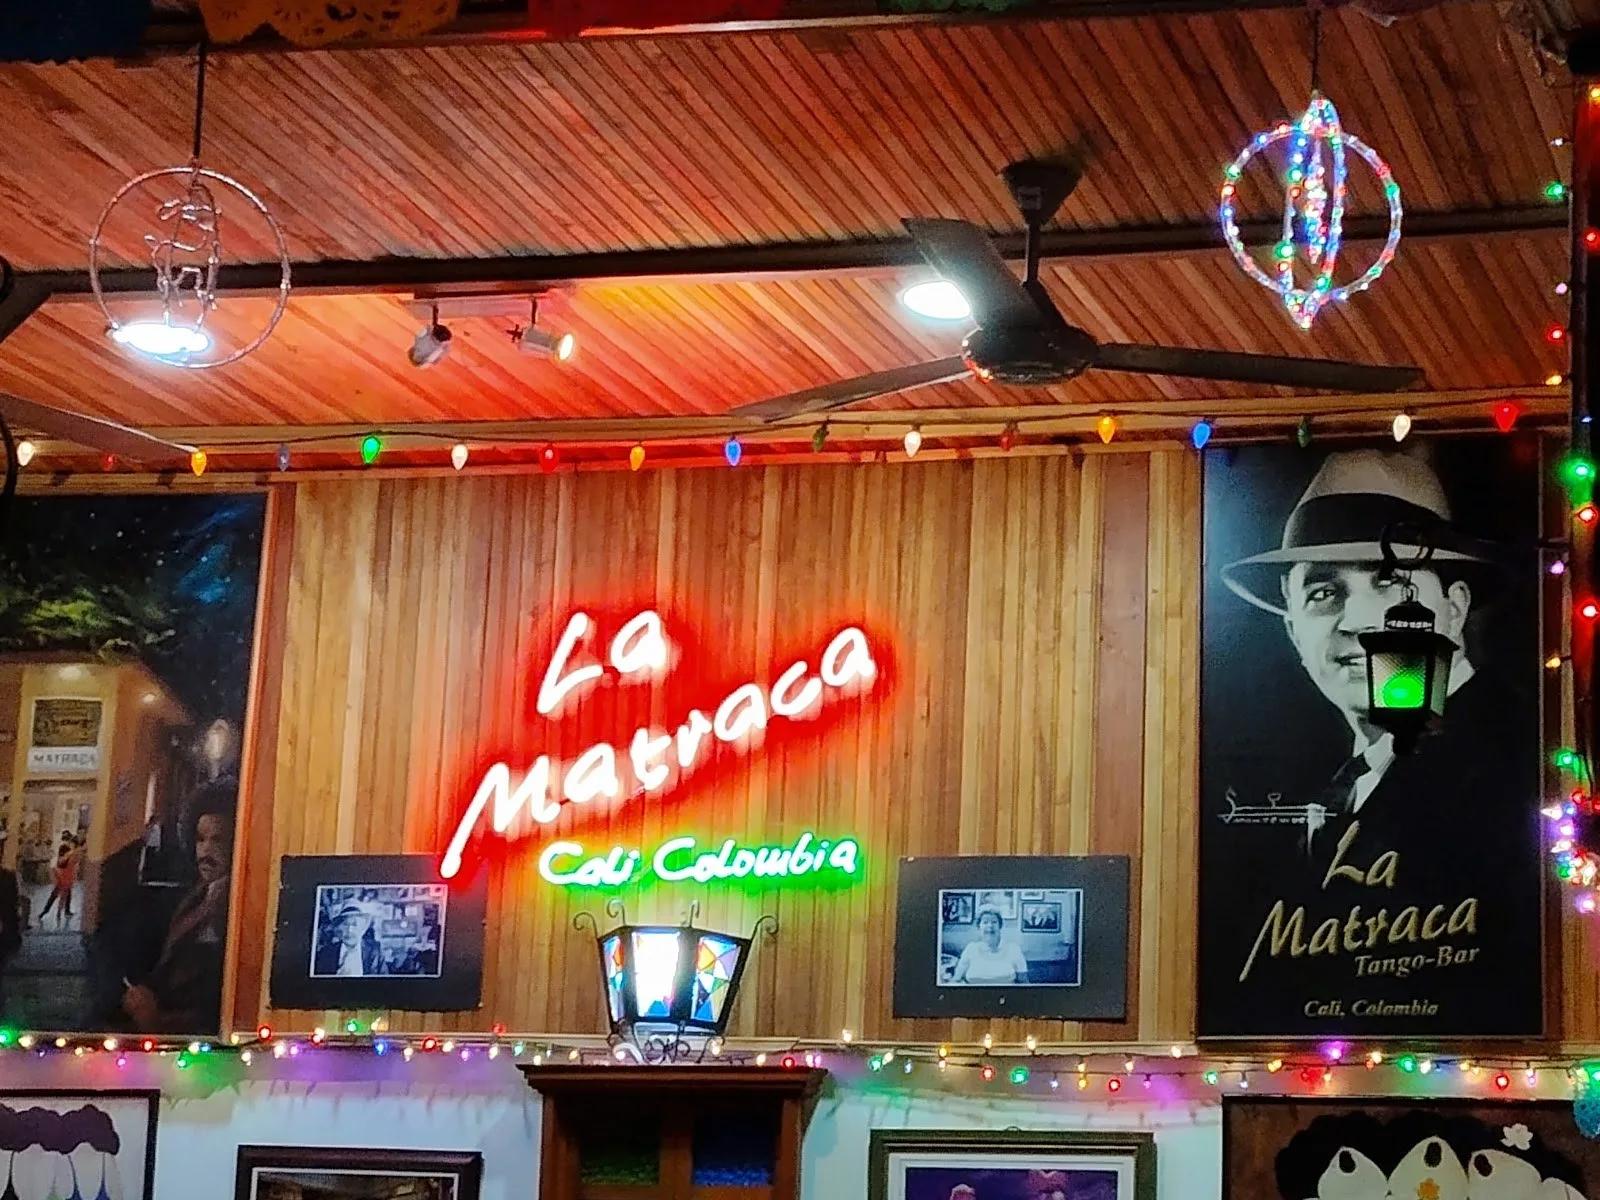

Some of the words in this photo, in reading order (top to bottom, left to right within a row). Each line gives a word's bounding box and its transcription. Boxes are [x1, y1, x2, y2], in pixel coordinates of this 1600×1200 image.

[536, 611, 668, 714] La
[439, 626, 878, 878] Matraca
[538, 840, 641, 885] Cali
[652, 831, 858, 884] Colombia
[1322, 820, 1399, 889] La
[1238, 897, 1479, 983] Matraca
[1354, 945, 1481, 978] Tango-Bar
[1303, 999, 1346, 1020] Cali,
[1351, 999, 1440, 1017] Colombia
